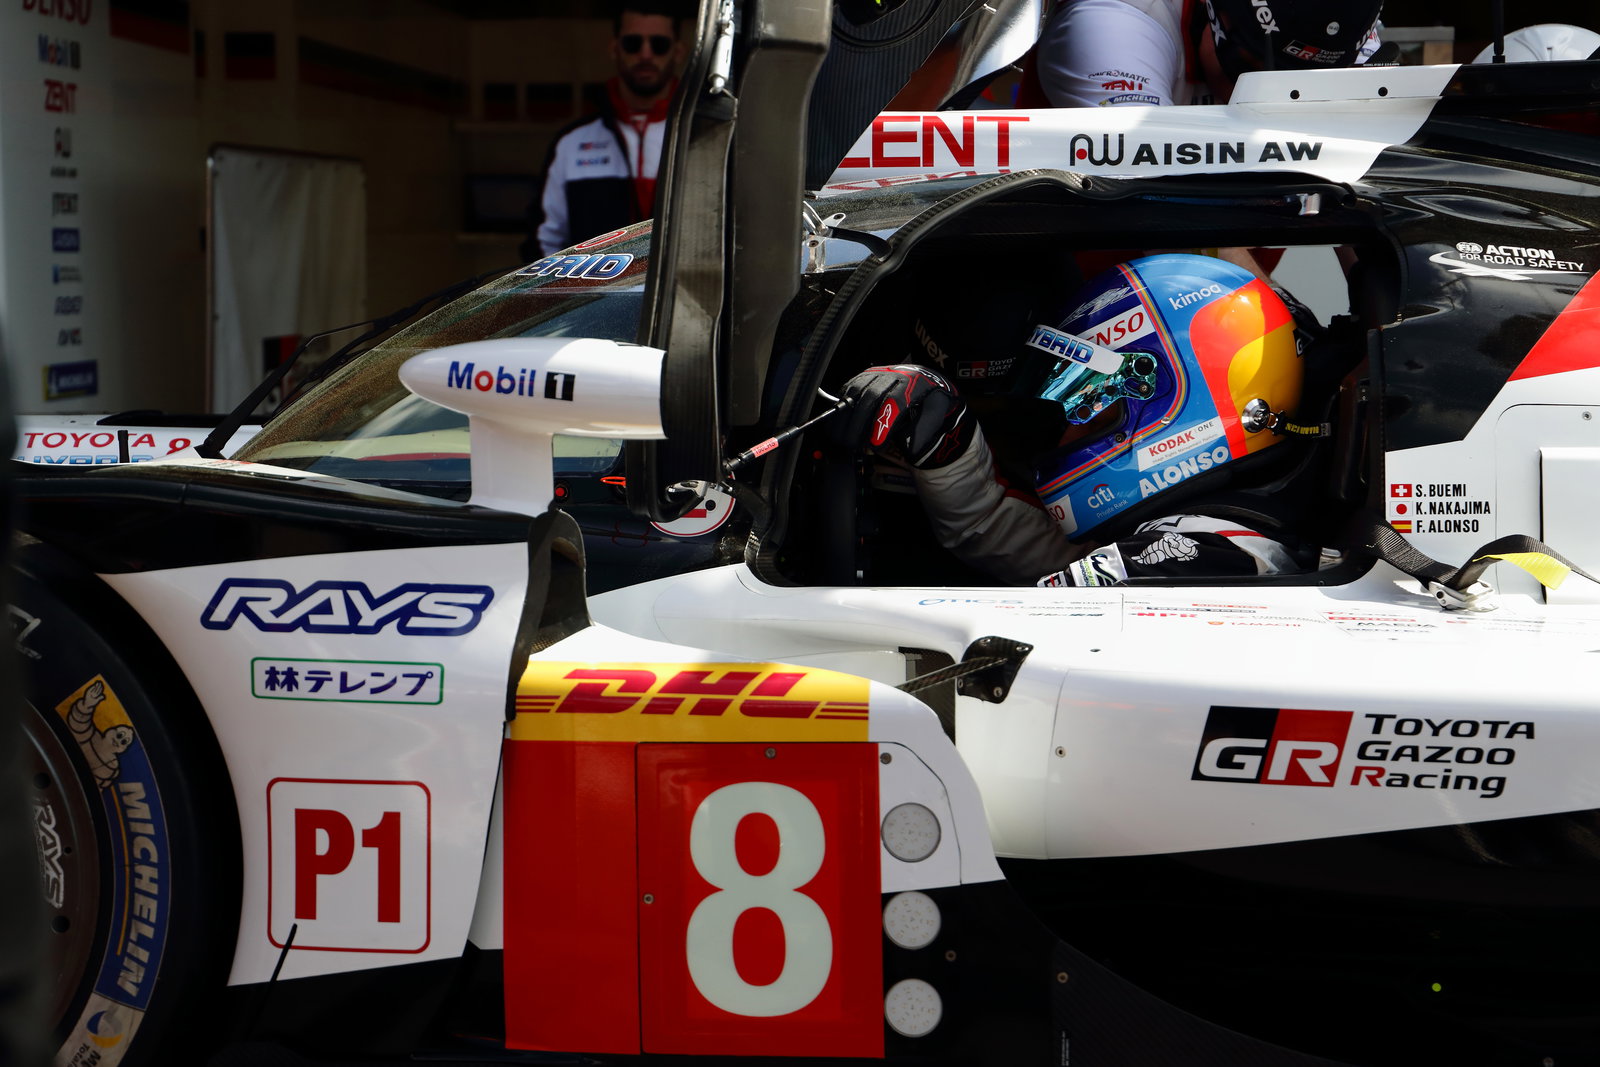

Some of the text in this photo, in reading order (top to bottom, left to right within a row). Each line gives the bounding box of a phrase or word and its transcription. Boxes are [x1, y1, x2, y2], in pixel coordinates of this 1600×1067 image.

[838, 113, 1030, 169] ENT
[1131, 141, 1323, 166] AISIN AW
[1460, 253, 1584, 272] FOR ROAD SAFETY
[1486, 244, 1556, 260] ACTION
[1168, 282, 1221, 311] kimoa
[447, 360, 537, 398] Mobil
[24, 432, 156, 448] TOYOA
[1148, 431, 1195, 458] KODAK
[1197, 420, 1214, 432] ONE
[1138, 445, 1230, 499] ALONSO
[1087, 485, 1115, 509] citi
[1415, 483, 1467, 498] S. BUEMI
[1415, 501, 1491, 515] K. NAKAJIMA
[1416, 519, 1480, 533] F. ALONSO
[200, 577, 495, 637] RAYS
[264, 665, 434, 696] 林テレンプ
[555, 668, 822, 719] DHL
[1364, 713, 1535, 740] TOYOTA
[1198, 737, 1340, 784] GR
[1356, 740, 1516, 766] GAZOO
[1350, 765, 1506, 799] Racing
[294, 808, 401, 923] P1
[116, 781, 159, 998] MICHELIN
[686, 781, 834, 1018] 8
